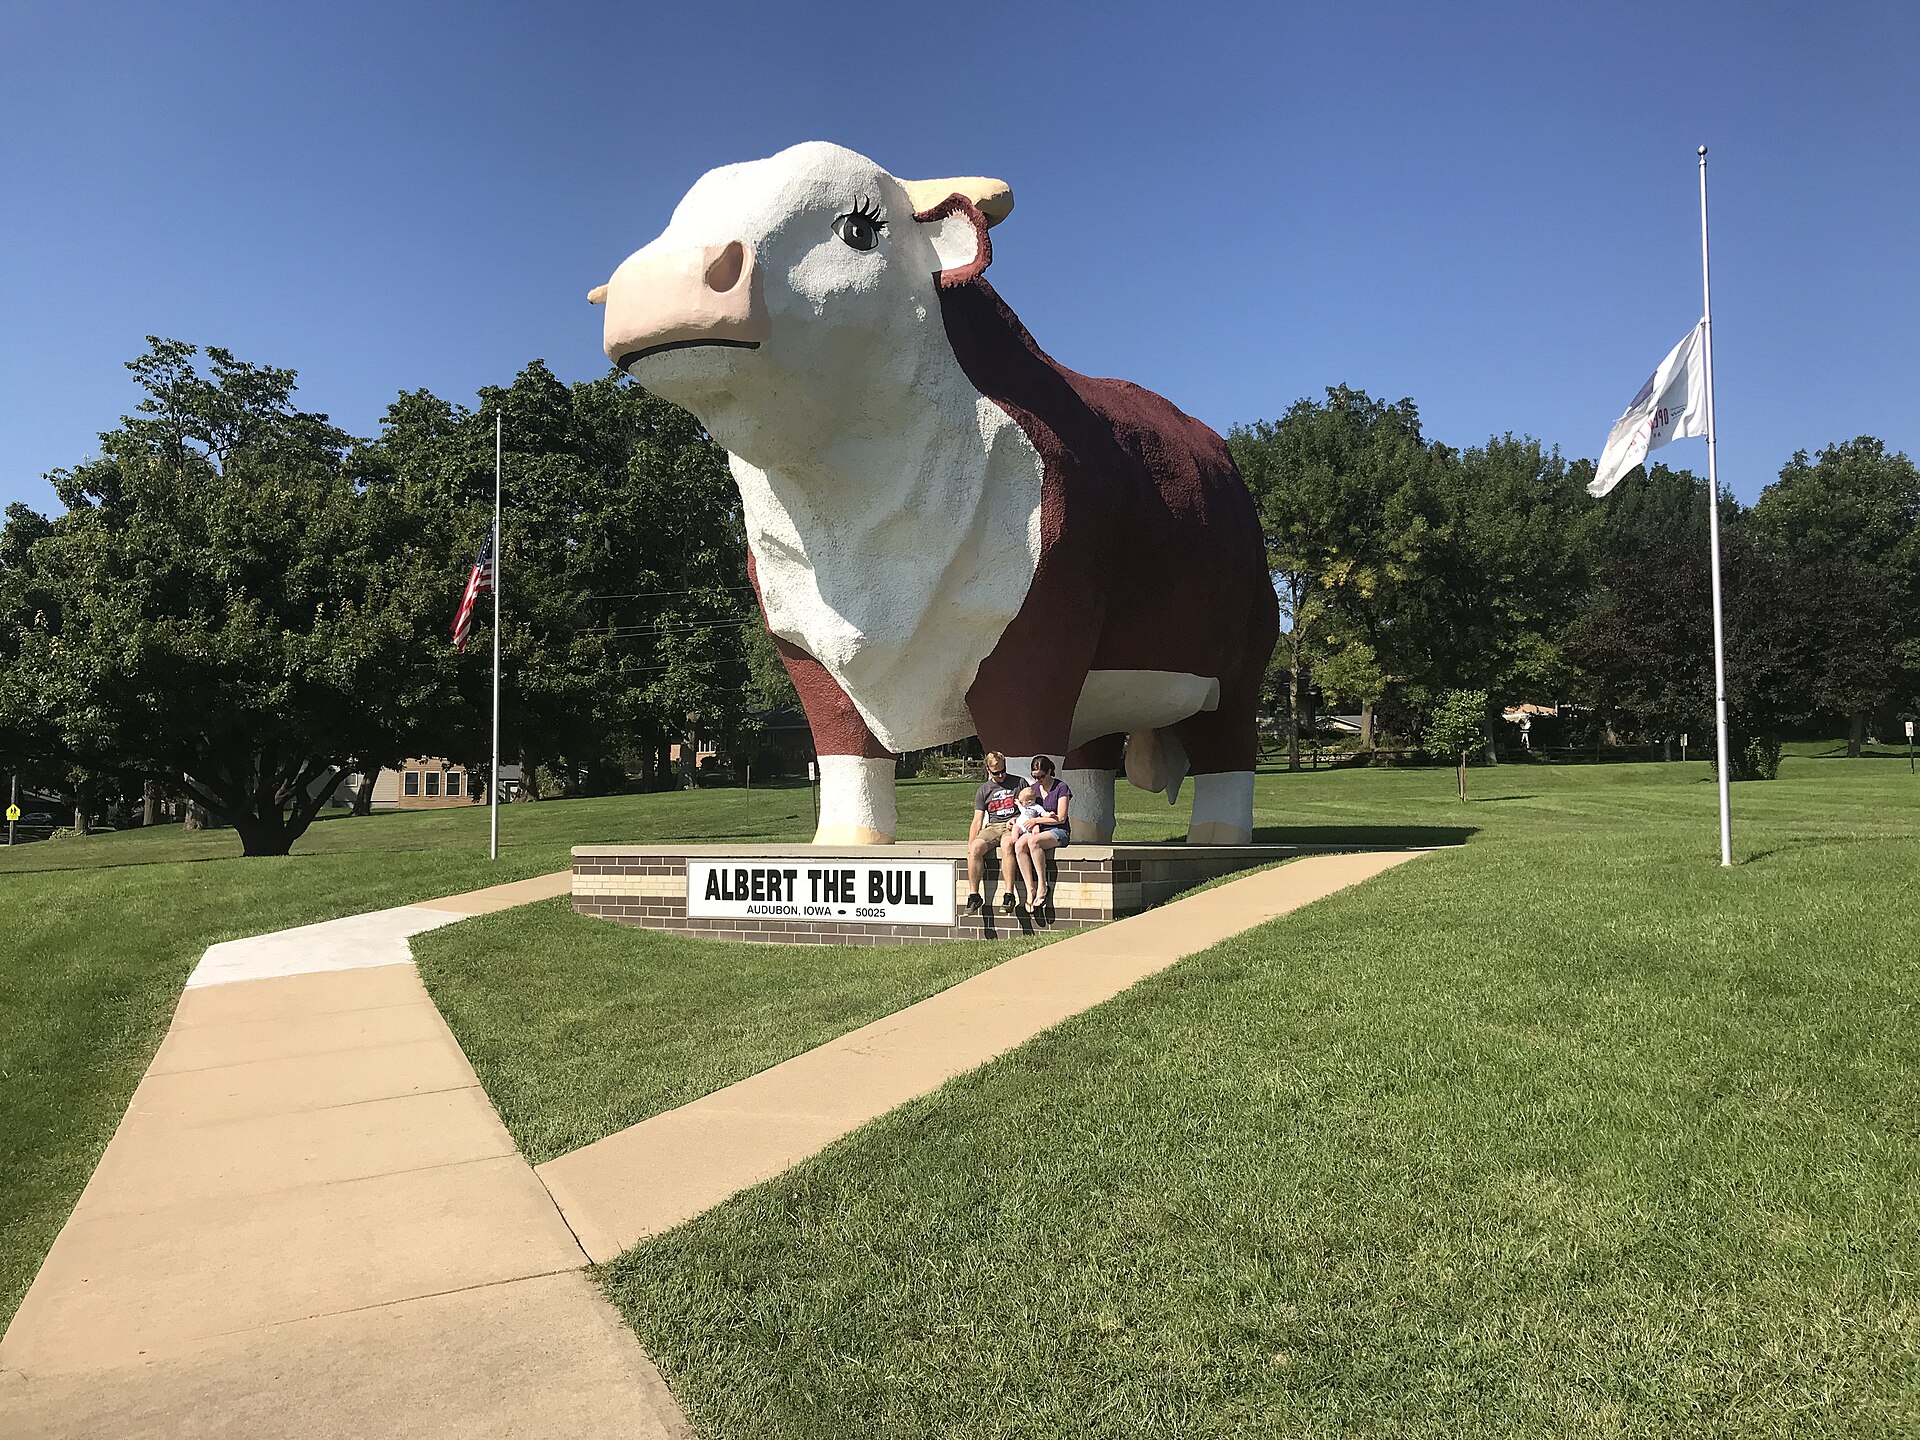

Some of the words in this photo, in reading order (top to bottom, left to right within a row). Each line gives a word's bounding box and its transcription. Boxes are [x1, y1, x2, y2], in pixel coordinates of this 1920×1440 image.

[704, 868, 798, 902] ALBERT
[807, 869, 856, 903] THE
[868, 870, 934, 906] BULL
[747, 904, 801, 916] AUDUBON,
[803, 906, 832, 916] IOWA
[855, 907, 886, 918] 50025
